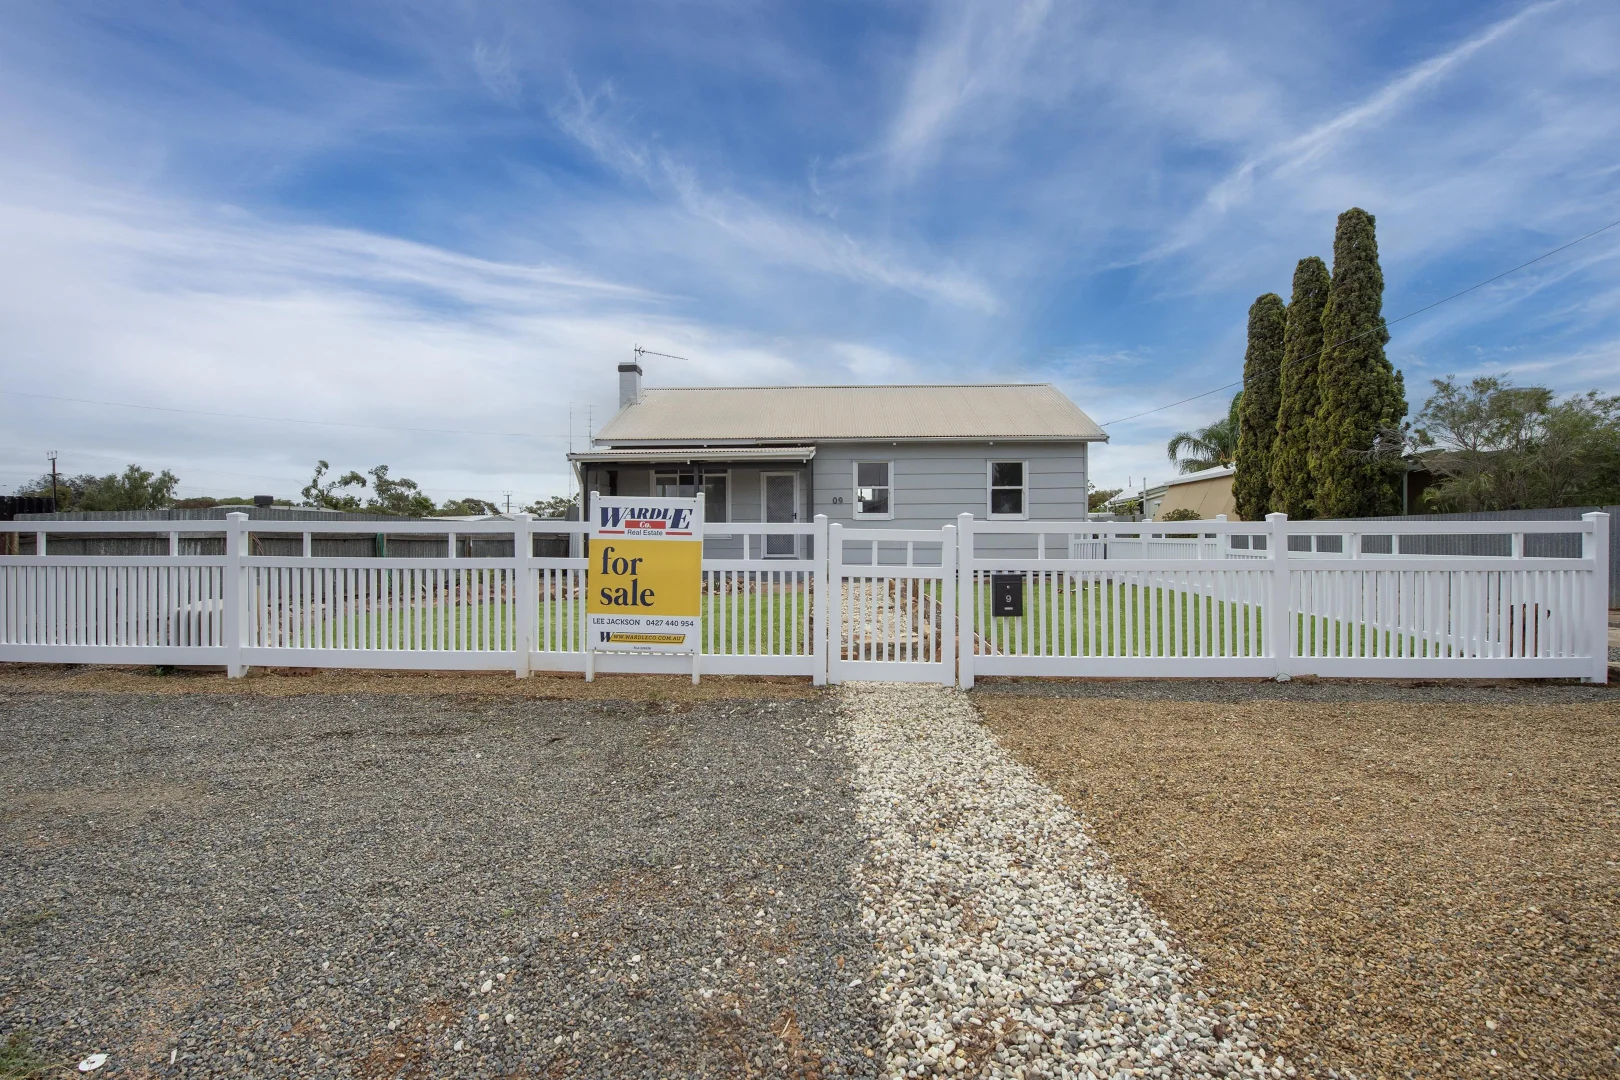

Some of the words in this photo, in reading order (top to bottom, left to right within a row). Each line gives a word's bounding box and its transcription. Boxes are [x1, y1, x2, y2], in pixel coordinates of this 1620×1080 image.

[832, 496, 844, 505] 09
[599, 507, 693, 529] WARDLE
[601, 547, 643, 575] for
[600, 578, 655, 606] sale
[1005, 595, 1012, 603] 9
